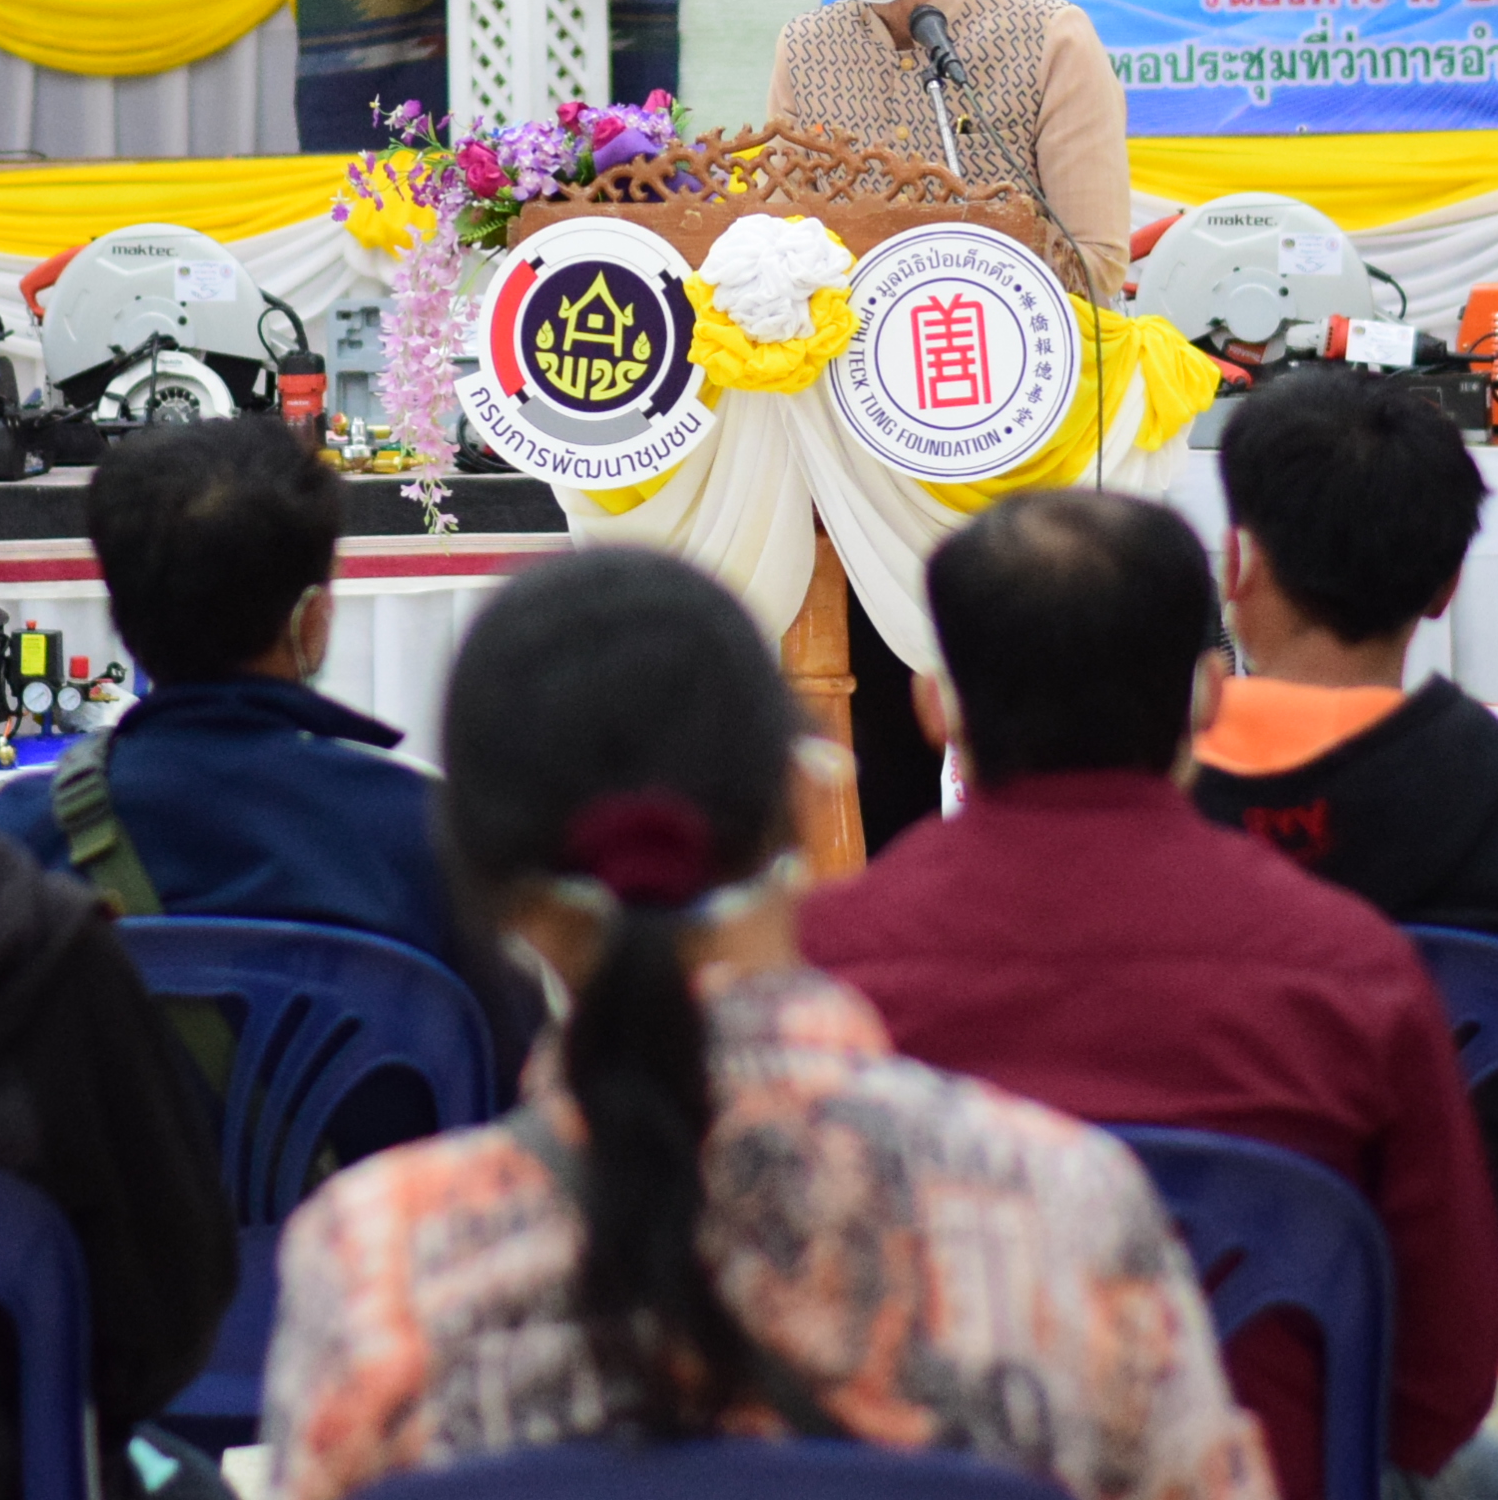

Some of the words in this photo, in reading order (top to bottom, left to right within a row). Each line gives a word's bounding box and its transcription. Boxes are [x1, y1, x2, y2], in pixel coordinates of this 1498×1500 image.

[1207, 214, 1274, 227] maktec
[111, 244, 176, 258] maktec
[848, 348, 871, 392] TECK
[469, 386, 704, 480] กรมการพัฒนาชุมชน
[859, 392, 898, 437] TUNG
[896, 427, 1003, 458] FOUNDATION
